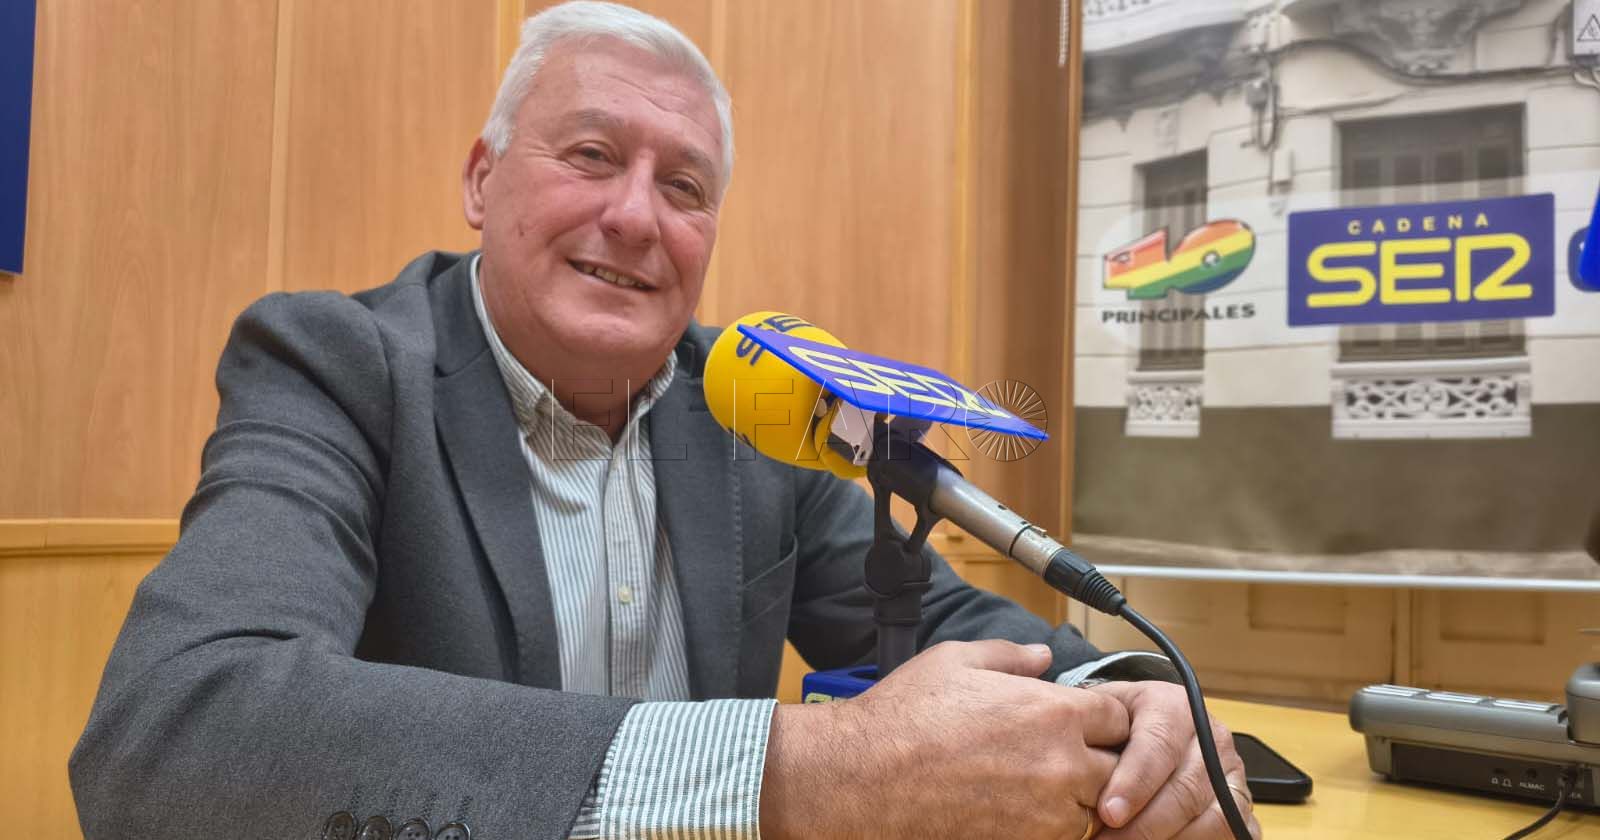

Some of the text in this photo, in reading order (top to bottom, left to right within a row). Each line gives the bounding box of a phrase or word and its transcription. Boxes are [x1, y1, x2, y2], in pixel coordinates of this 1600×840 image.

[1347, 213, 1488, 235] CADENA
[1306, 232, 1533, 308] SER
[1102, 304, 1255, 323] PRINCIPALES
[787, 345, 1012, 418] SER
